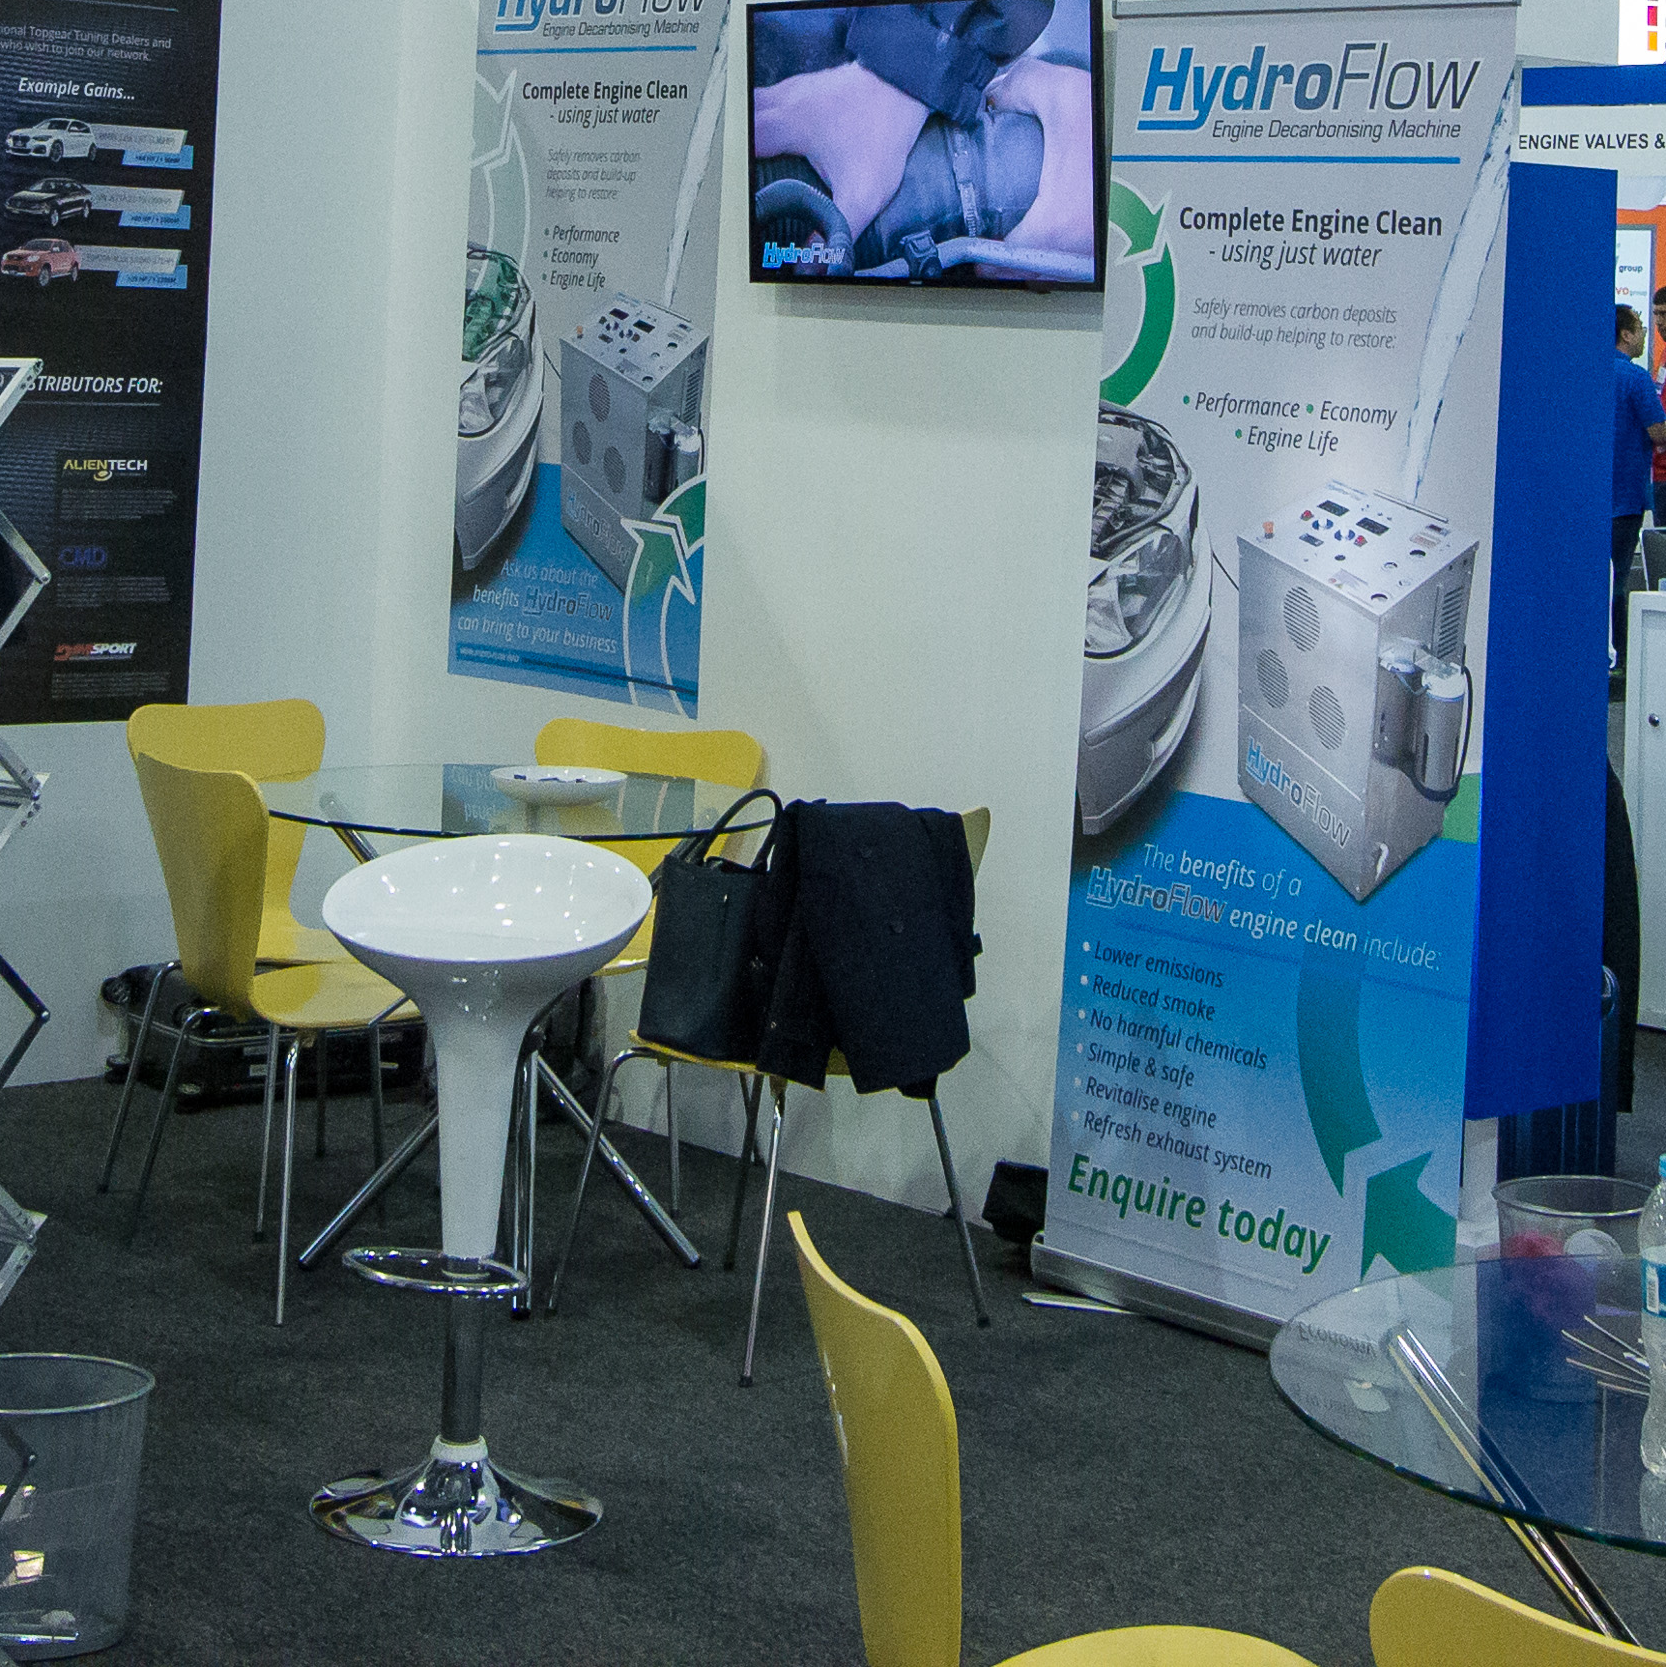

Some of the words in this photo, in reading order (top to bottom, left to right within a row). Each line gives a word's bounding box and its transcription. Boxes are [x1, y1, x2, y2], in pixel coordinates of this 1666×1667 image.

[30, 25, 71, 41] Topgear
[74, 29, 109, 45] Tuning
[111, 33, 149, 47] Dealers
[152, 37, 171, 49] and
[543, 22, 576, 40] Engine
[578, 21, 650, 38] Decarbonising
[653, 19, 699, 34] Machine
[87, 47, 105, 58] our
[18, 77, 79, 99] Example
[84, 82, 135, 101] Gains...
[522, 81, 589, 104] Complete
[594, 81, 642, 104] Engine
[647, 80, 688, 100] Clean
[1137, 41, 1481, 131] HydroFlow
[558, 106, 591, 127] using
[593, 105, 618, 125] just
[621, 105, 660, 124] water
[1212, 120, 1264, 142] Engine
[1268, 120, 1383, 142] Decarbonising
[1388, 119, 1461, 138] Machine
[1518, 134, 1579, 150] ENGINE
[1584, 133, 1649, 149] VALVES
[1654, 133, 1666, 149] &
[552, 225, 620, 244] Performance
[1179, 207, 1285, 237] Complete
[1291, 209, 1369, 239] Engine
[1376, 210, 1442, 236] Clean
[551, 248, 599, 267] Economy
[762, 242, 846, 269] HydroFlow
[1221, 241, 1274, 270] using
[1276, 243, 1318, 270] just
[1323, 246, 1383, 267] water
[550, 271, 584, 288] Engine
[587, 272, 606, 289] Life
[1193, 298, 1231, 319] Safely
[1233, 301, 1286, 319] removes
[1290, 302, 1340, 321] carbon
[1343, 305, 1397, 326] deposits
[1191, 324, 1216, 341] and
[1219, 324, 1273, 345] build-up
[1277, 327, 1326, 350] helping
[1330, 330, 1343, 345] to
[1347, 331, 1397, 349] restore:
[128, 378, 163, 394] FOR:
[1195, 392, 1300, 420] Performance
[1320, 401, 1398, 430] Economy
[1247, 425, 1302, 452] Engine
[1308, 430, 1339, 453] Life
[64, 459, 148, 472] ALIENTECH
[472, 585, 520, 609] benefits
[523, 587, 613, 621] HydroFlow
[457, 616, 479, 631] can
[483, 618, 514, 641] bring
[563, 627, 618, 654] business
[1245, 737, 1350, 848] HydroFlow
[1144, 843, 1175, 873] The
[1180, 850, 1255, 889] benefits
[1262, 869, 1285, 900] of
[1288, 877, 1302, 896] a
[1085, 864, 1228, 924] HydroFlow
[1229, 904, 1299, 941] engine
[1303, 919, 1358, 953] clean
[1362, 930, 1442, 971] include:
[1094, 942, 1141, 970] Lower
[1145, 953, 1224, 988] emissions
[1092, 975, 1159, 1008] Reduced
[1163, 993, 1216, 1021] smoke
[1090, 1009, 1113, 1032] No
[1116, 1015, 1182, 1050] harmful
[1185, 1034, 1268, 1070] chemicals
[1087, 1043, 1140, 1074] Simple
[1144, 1057, 1158, 1077] &
[1161, 1063, 1195, 1089] safe
[1085, 1077, 1160, 1112] Revitalise
[1163, 1100, 1217, 1129] engine
[1084, 1110, 1142, 1143] Refresh
[1146, 1128, 1209, 1162] exhaust
[1214, 1149, 1272, 1180] system
[1067, 1153, 1207, 1228] Enquire
[1218, 1195, 1332, 1274] today
